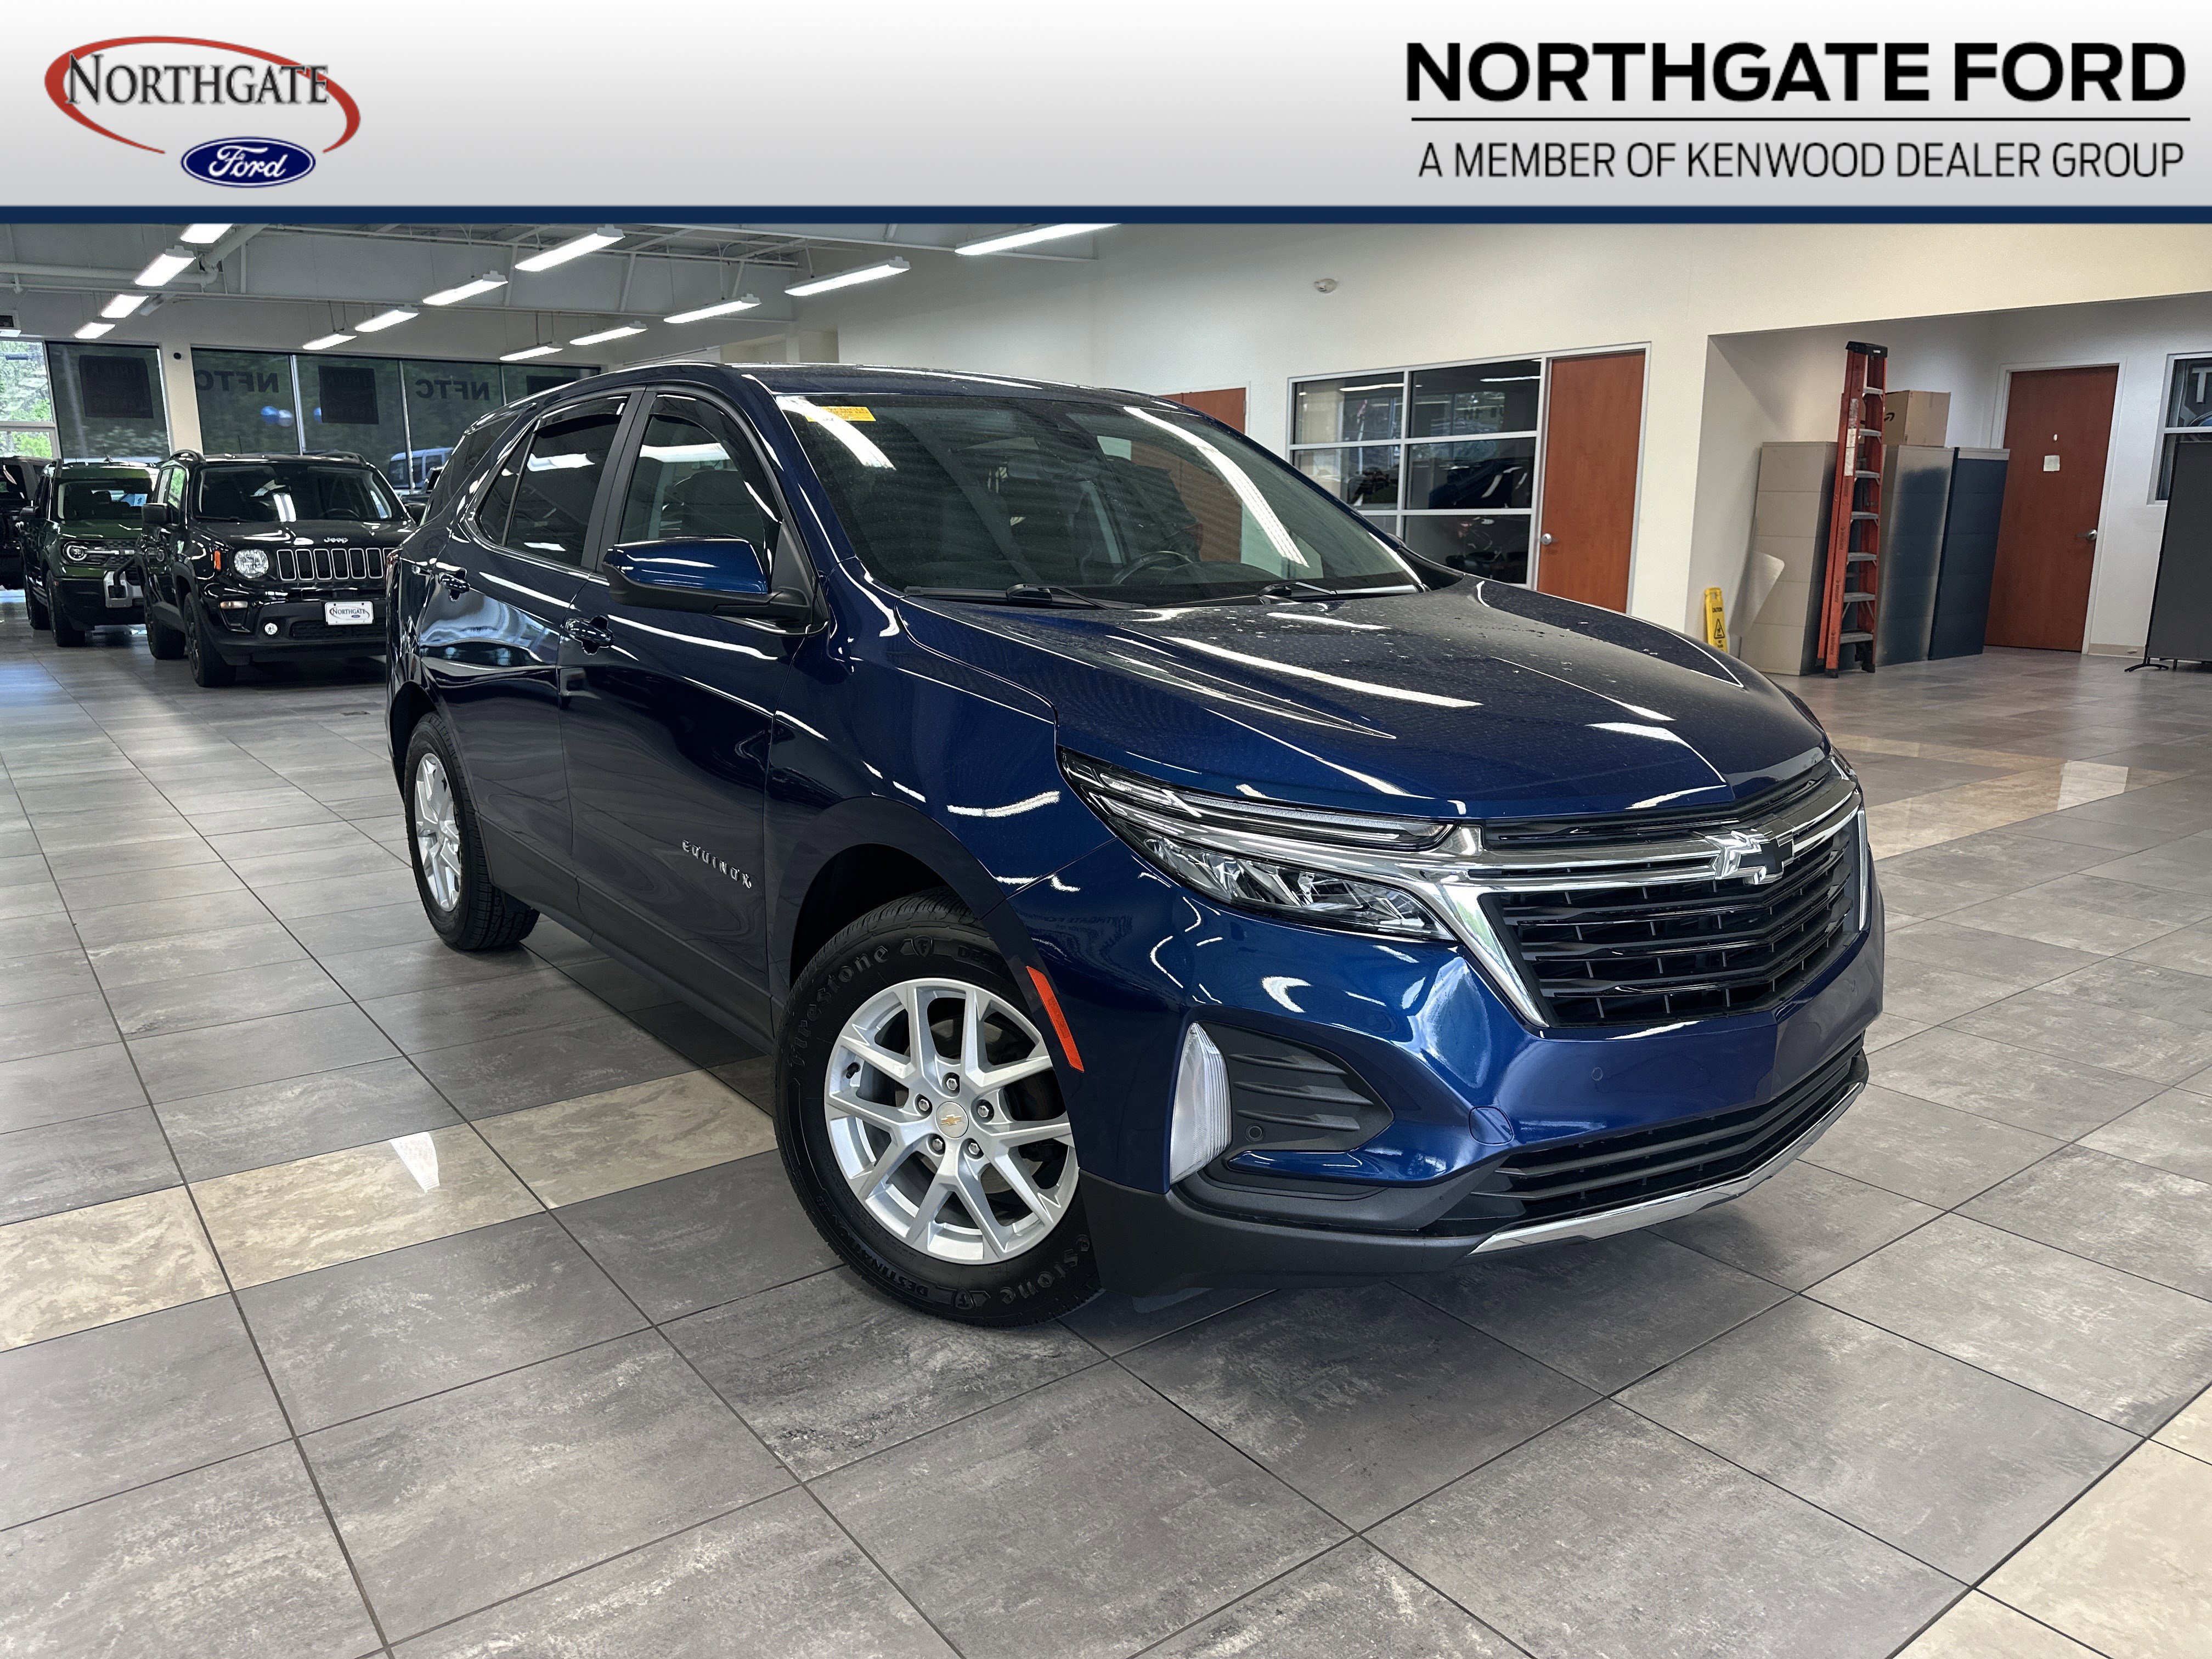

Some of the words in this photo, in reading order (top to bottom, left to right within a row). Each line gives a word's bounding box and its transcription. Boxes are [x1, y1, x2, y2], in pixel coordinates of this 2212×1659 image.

[682, 839, 752, 889] EQUINOX
[787, 945, 889, 1068] Firestone
[999, 1234, 1091, 1304] estone
